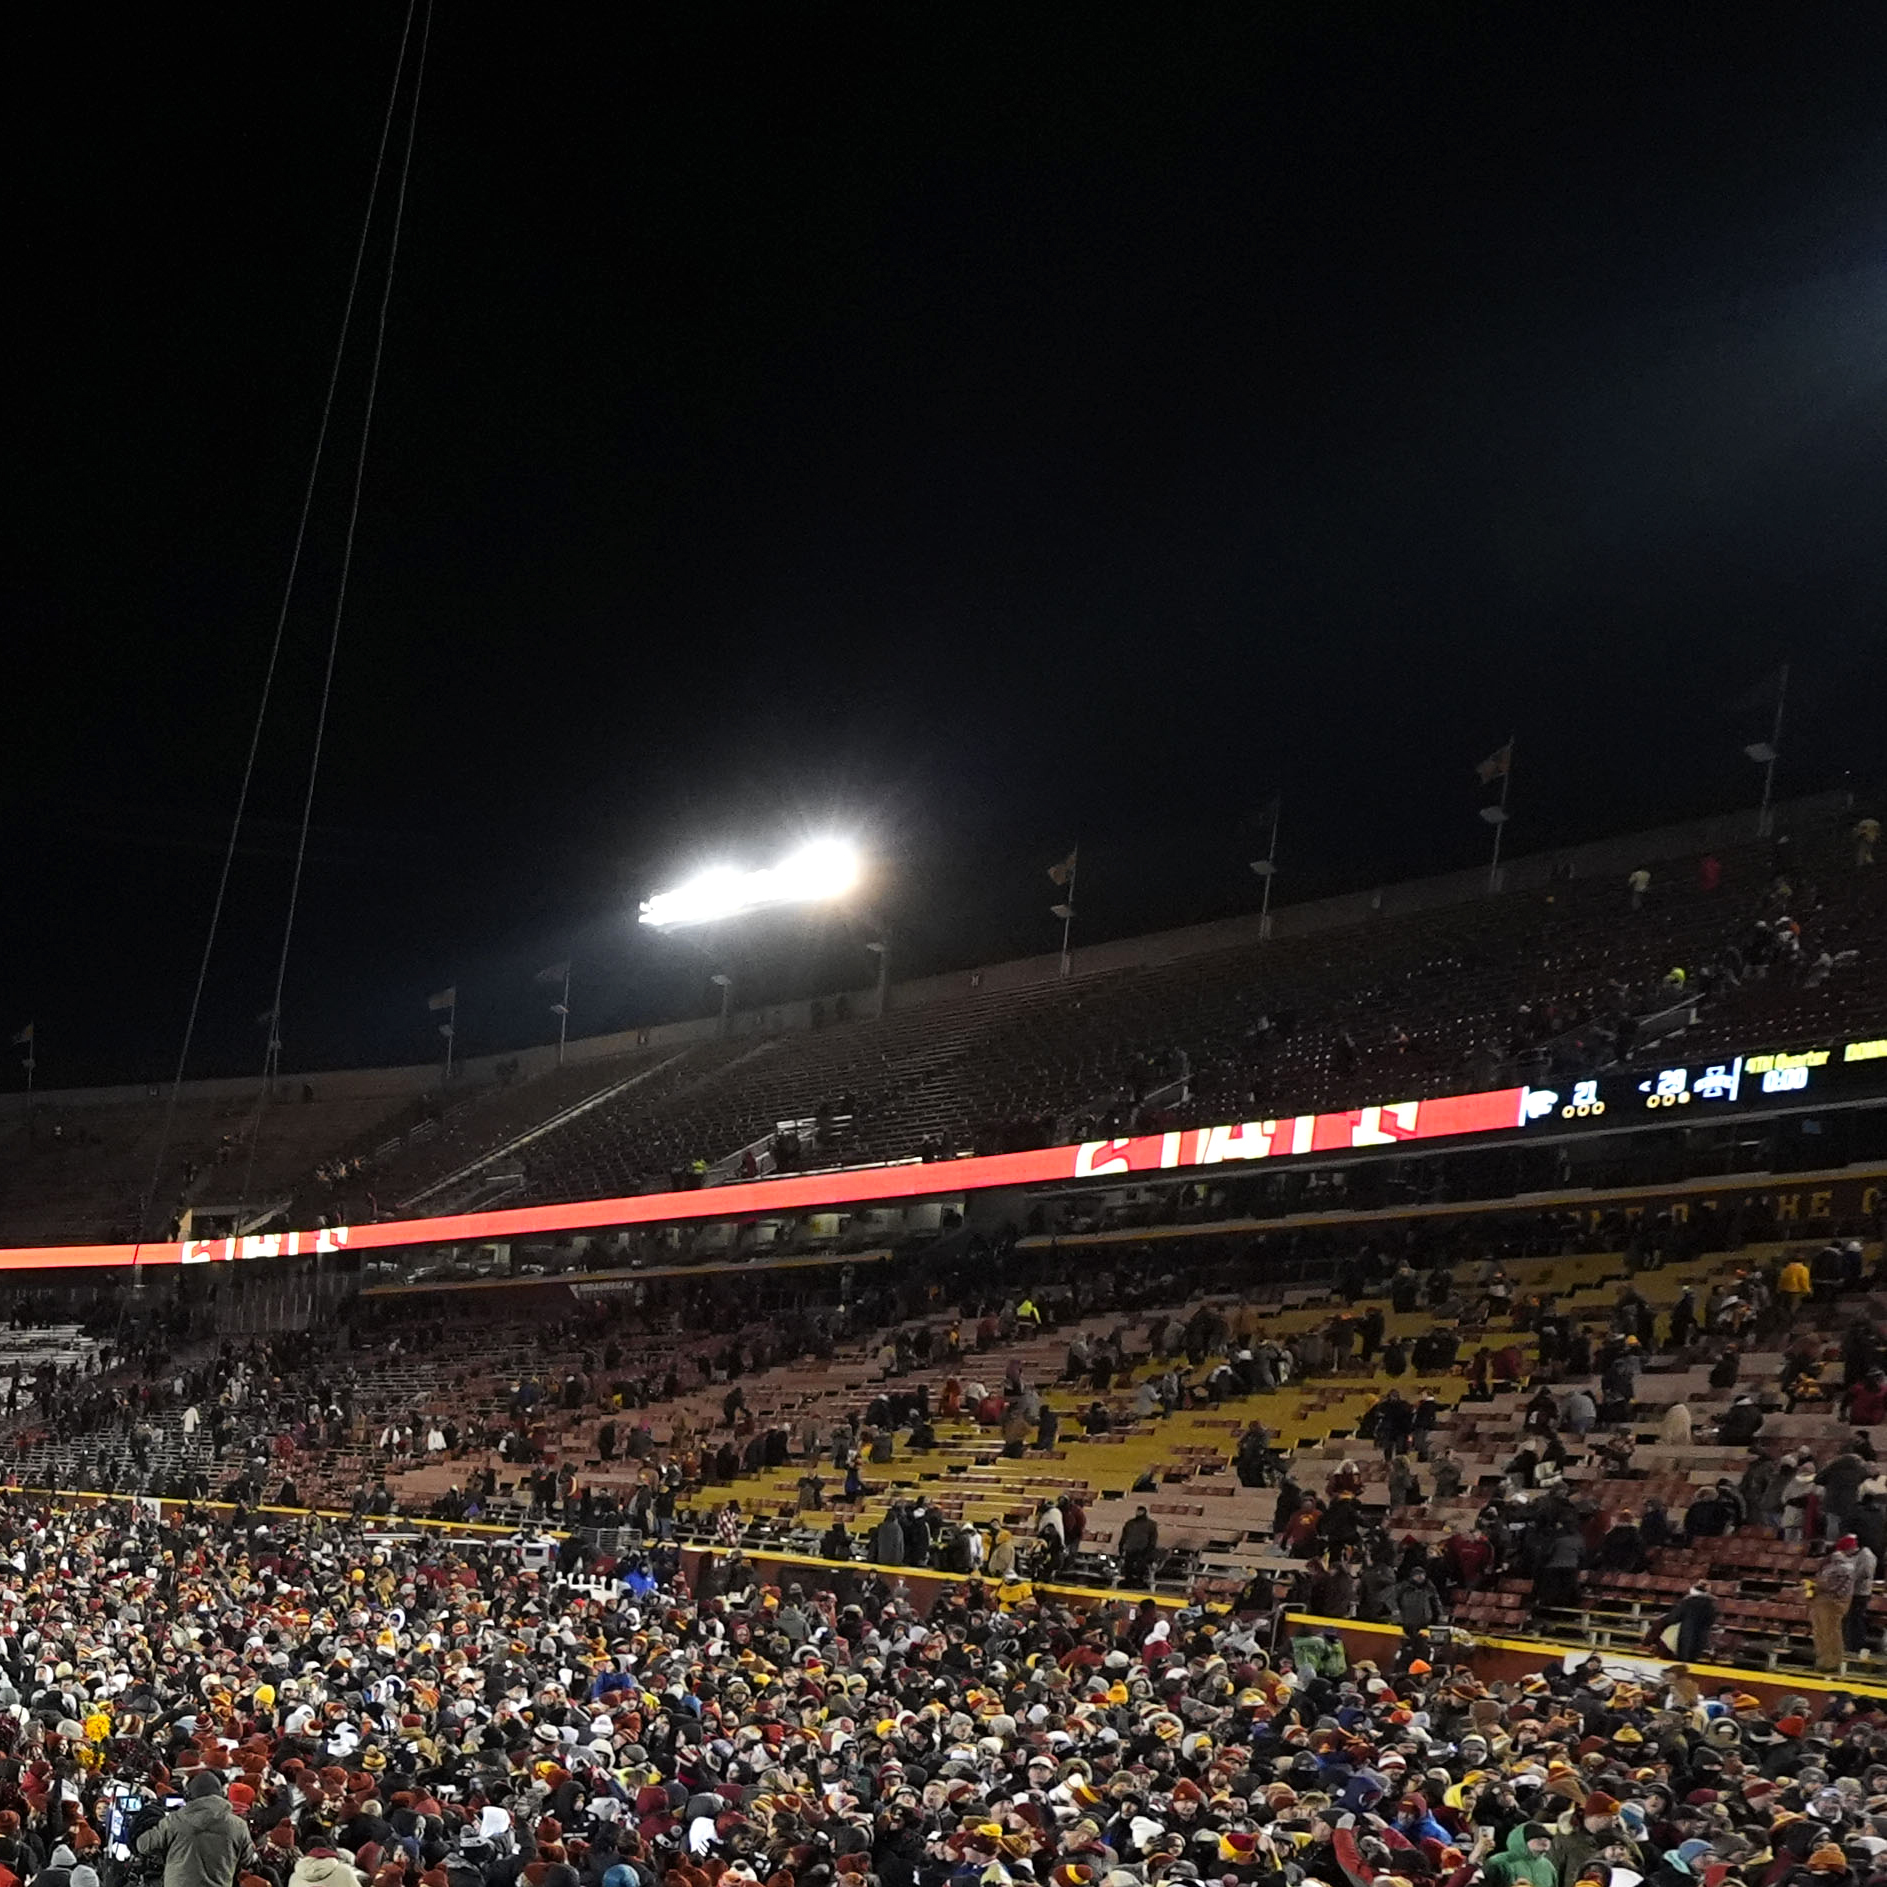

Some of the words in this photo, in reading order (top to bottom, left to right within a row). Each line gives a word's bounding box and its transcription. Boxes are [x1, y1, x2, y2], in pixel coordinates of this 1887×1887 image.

[1573, 1080, 1597, 1106] 21
[1655, 1068, 1687, 1096] 29
[1762, 1067, 1809, 1093] 0:00
